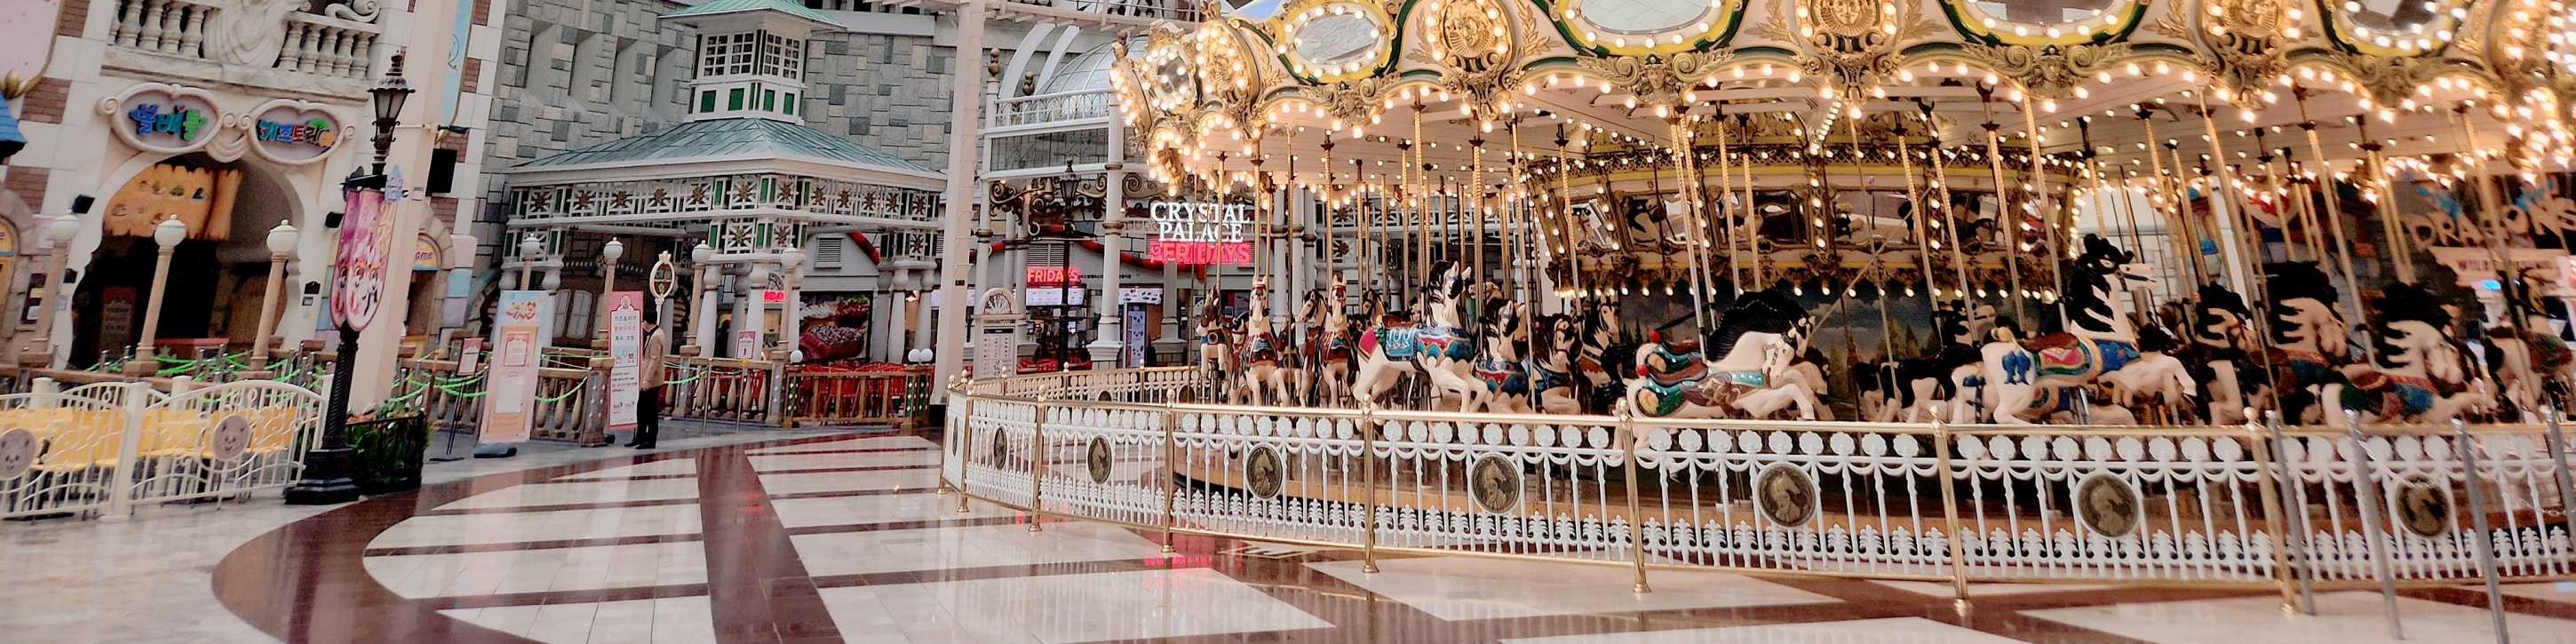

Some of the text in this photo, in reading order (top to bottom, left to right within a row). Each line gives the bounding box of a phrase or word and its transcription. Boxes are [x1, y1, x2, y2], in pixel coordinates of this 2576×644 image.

[1150, 202, 1251, 224] CRYSTAL
[1157, 221, 1244, 242] PALACE
[1162, 240, 1252, 264] FRIDAYS
